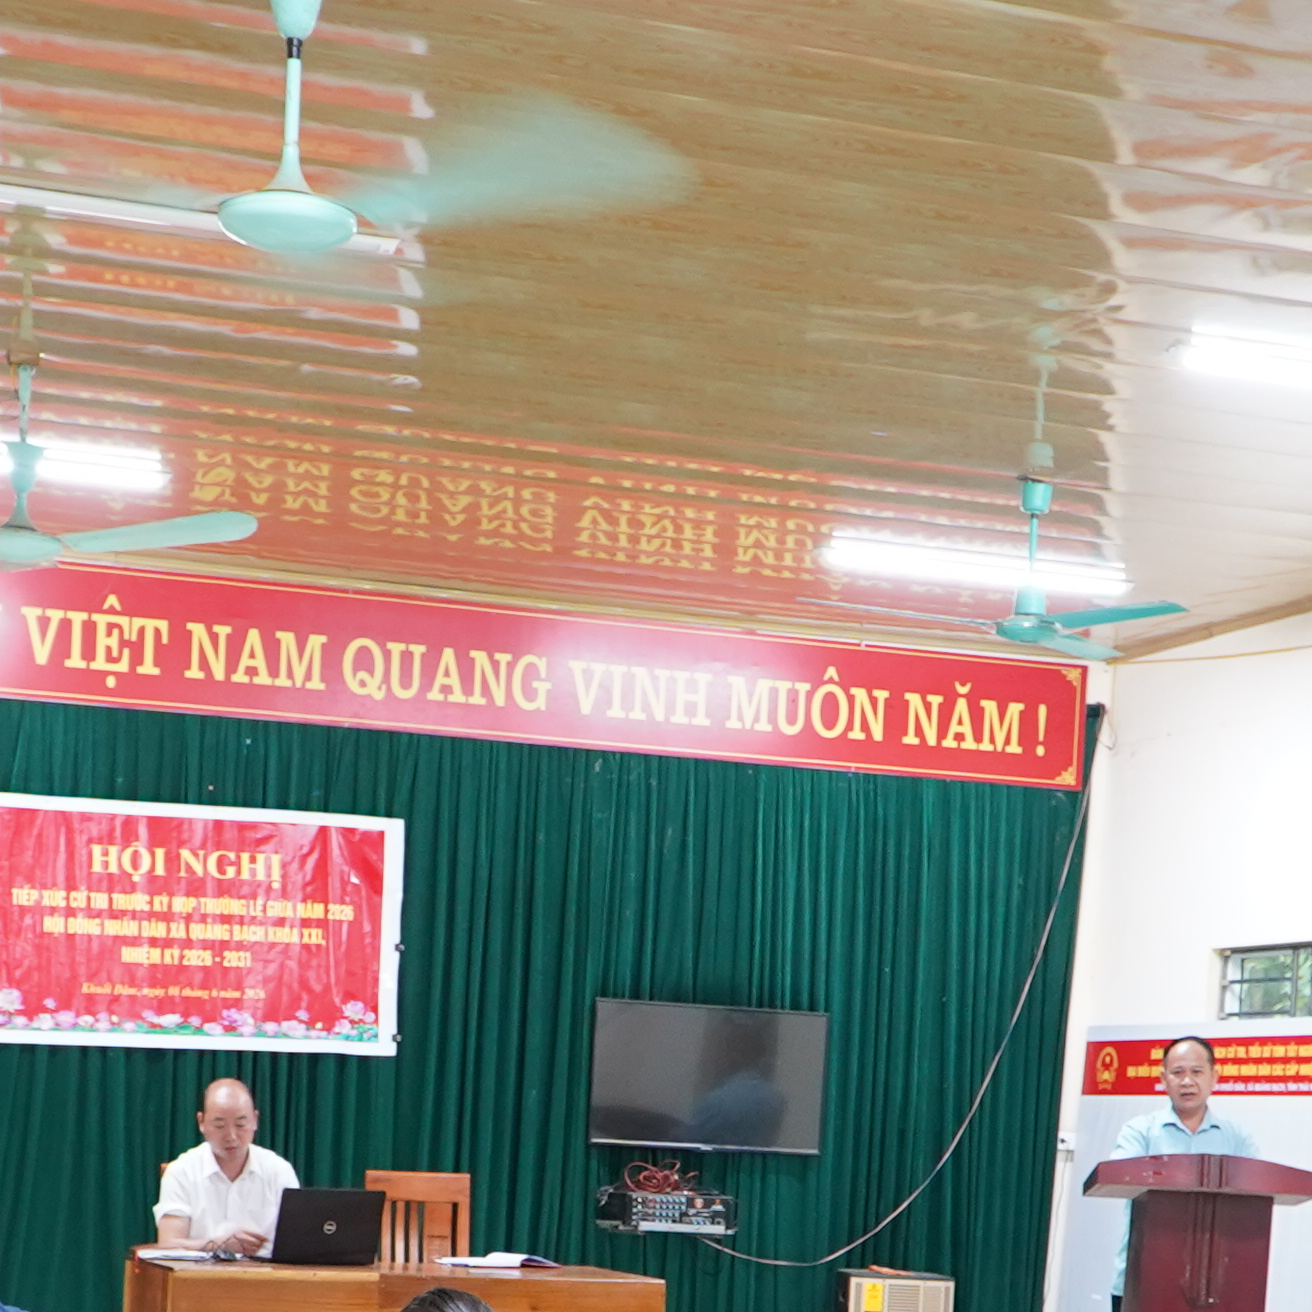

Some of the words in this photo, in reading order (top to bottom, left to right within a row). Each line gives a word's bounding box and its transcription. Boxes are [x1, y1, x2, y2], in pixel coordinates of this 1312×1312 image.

[21, 594, 169, 689] VIỆT
[185, 621, 327, 693] NAM
[342, 637, 552, 713] QUANG
[568, 659, 712, 728] VINH
[725, 665, 889, 743] MUÔN
[902, 681, 1026, 755] NĂM
[90, 841, 167, 882] HỘI
[177, 848, 282, 889] NGHỊ
[89, 891, 109, 910] TRI
[222, 950, 252, 968] 2031
